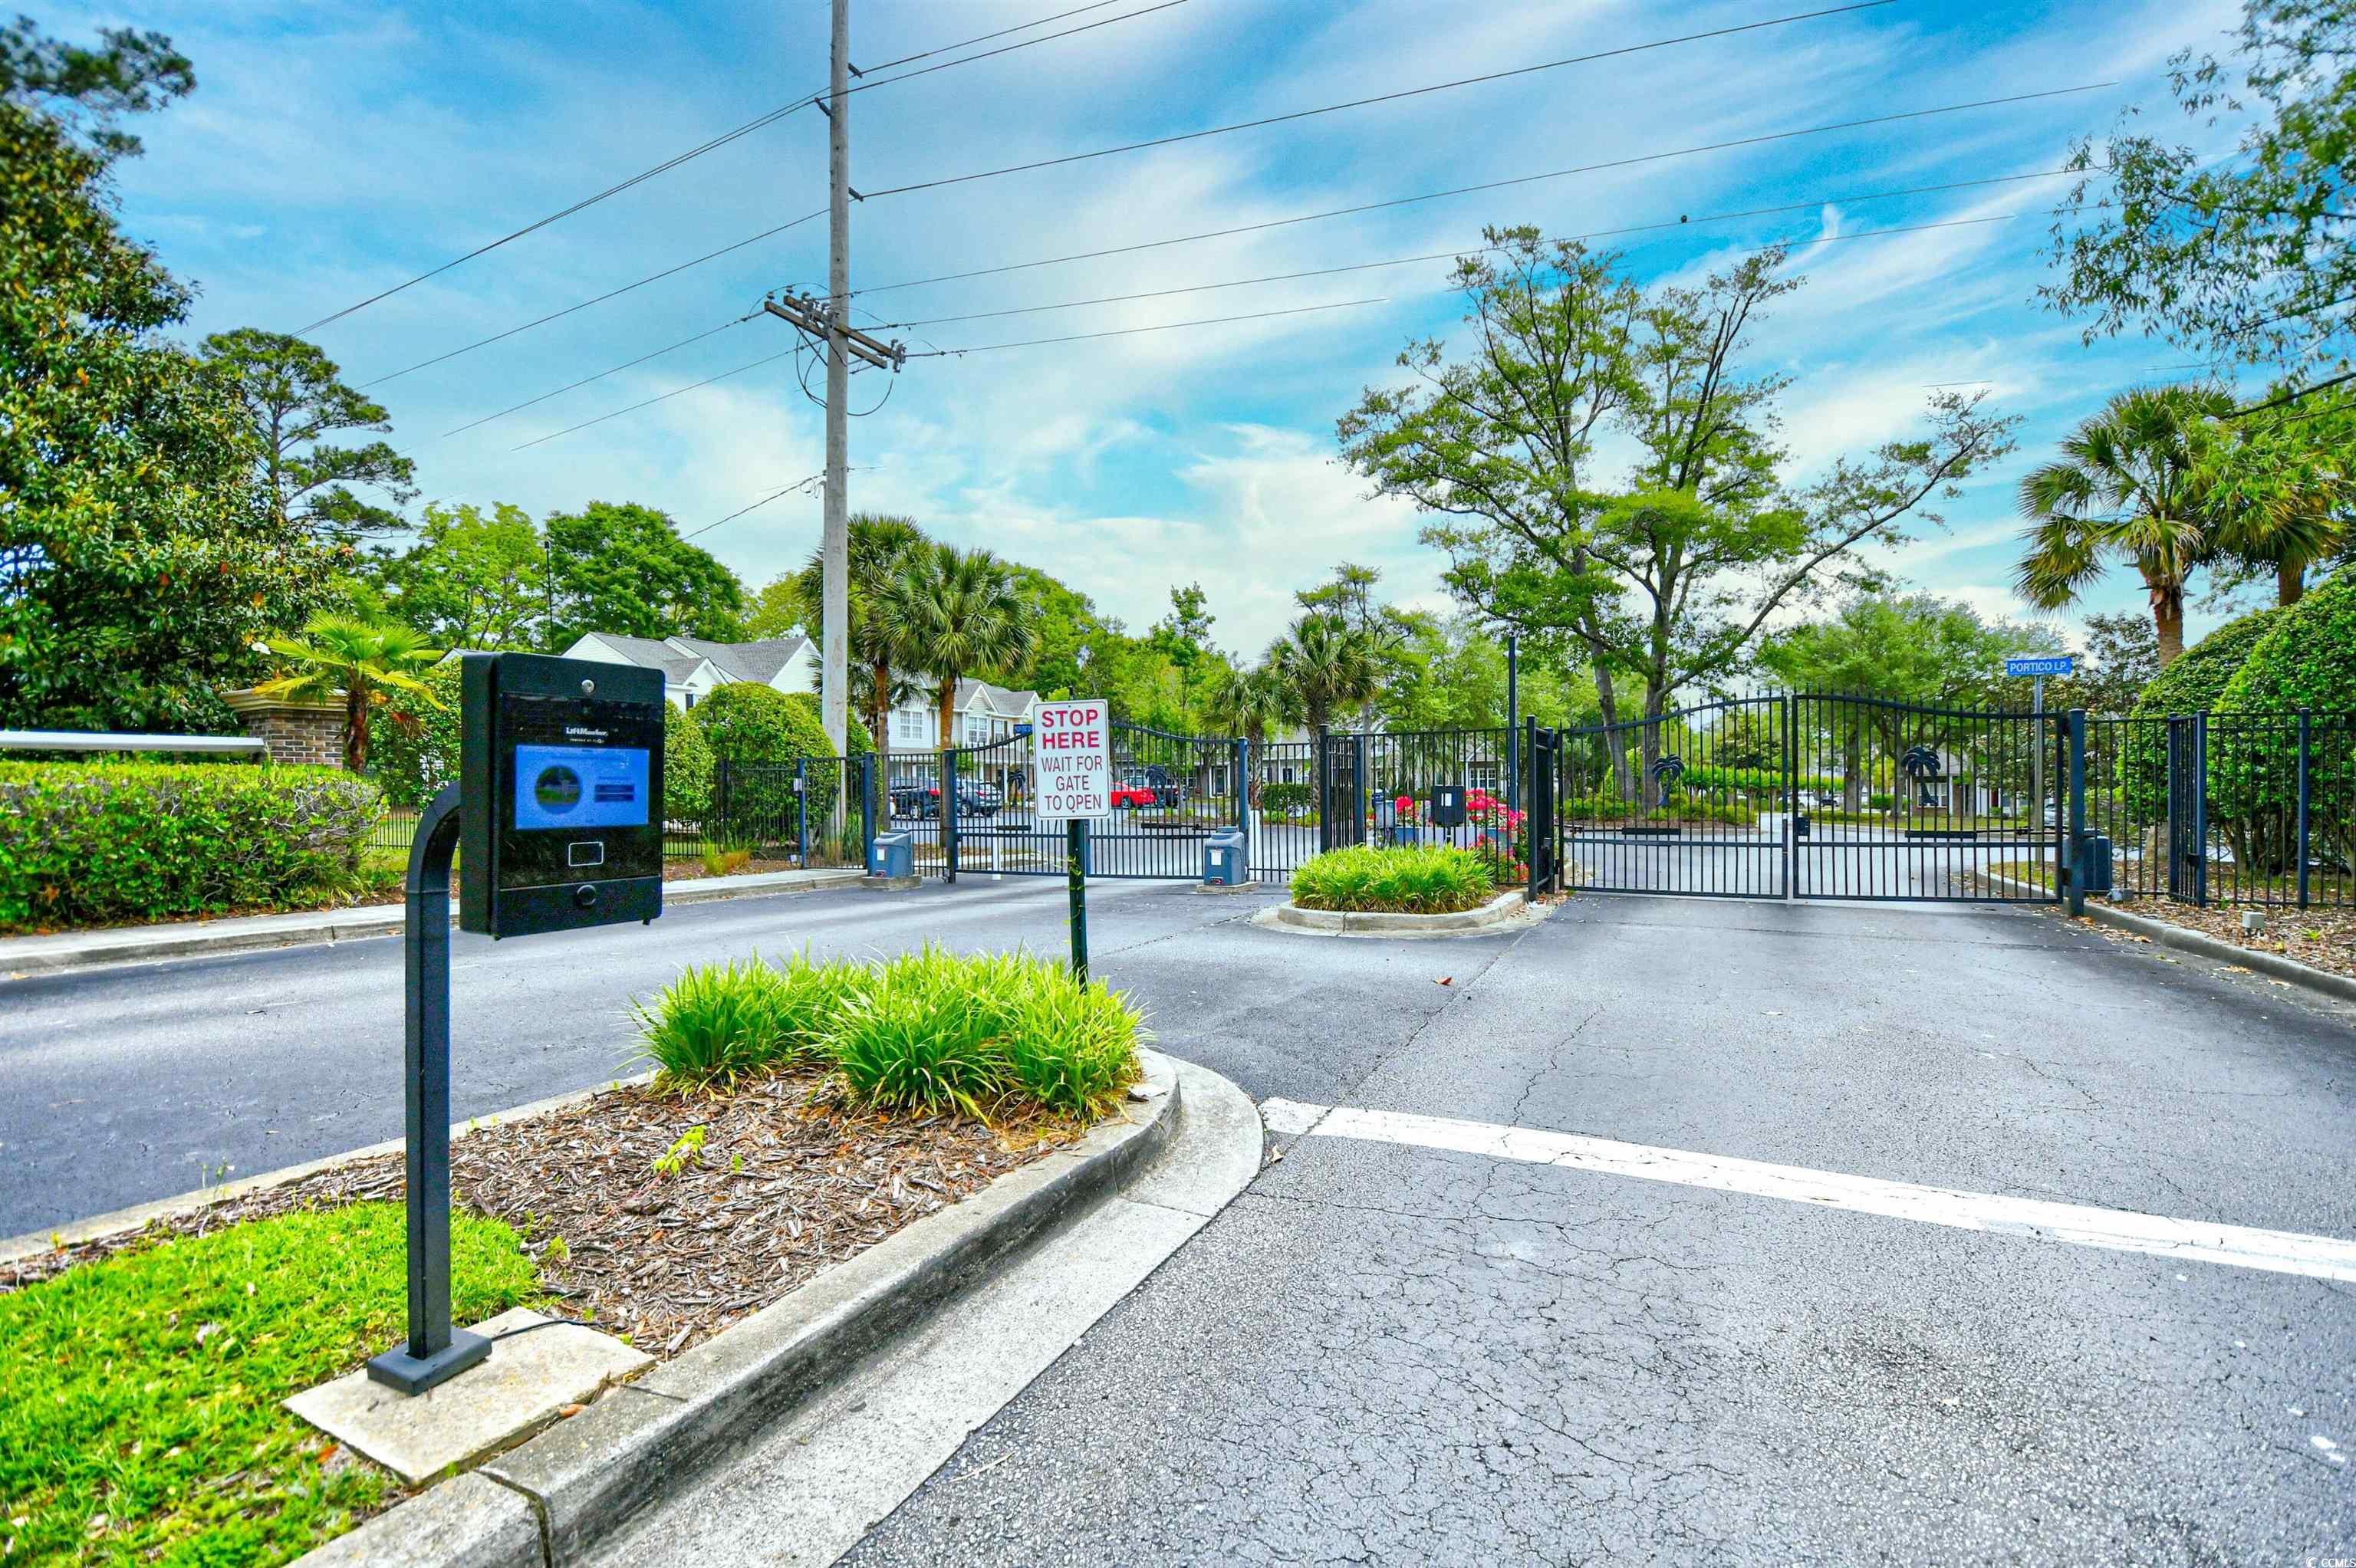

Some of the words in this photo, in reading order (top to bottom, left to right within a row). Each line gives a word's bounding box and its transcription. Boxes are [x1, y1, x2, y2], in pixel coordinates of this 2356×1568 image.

[2010, 662, 2052, 672] PORTICO
[1041, 709, 1098, 728] STOP
[1042, 731, 1100, 749] HERE
[1041, 756, 1072, 772] WAIT
[1077, 755, 1103, 771] FOR
[1056, 775, 1089, 791] GATE
[1045, 795, 1061, 810] TO
[1066, 794, 1101, 810] OPEN
